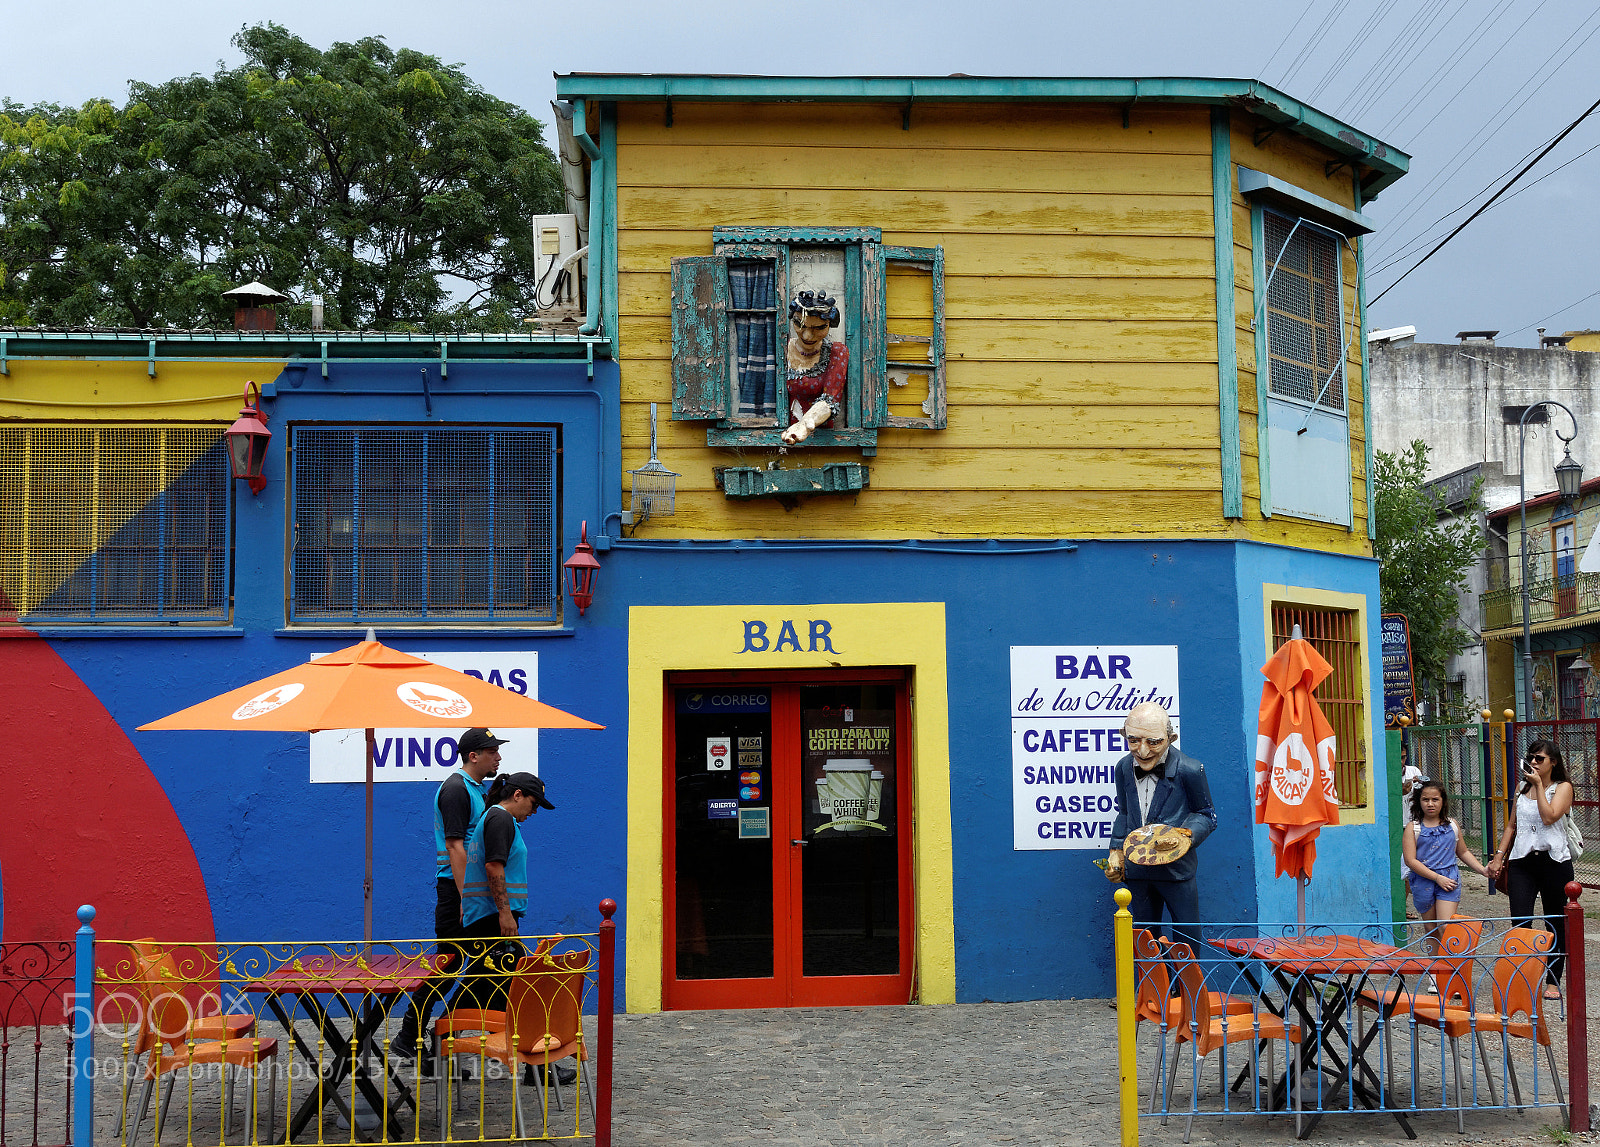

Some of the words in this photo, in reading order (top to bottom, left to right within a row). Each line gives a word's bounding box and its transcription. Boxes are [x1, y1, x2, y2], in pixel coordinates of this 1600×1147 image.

[732, 619, 844, 655] BAR
[1055, 655, 1133, 679] BAR
[711, 694, 768, 706] CORREO
[1018, 688, 1045, 711] de
[1052, 688, 1082, 711] los
[406, 698, 467, 716] BALCARCE
[808, 729, 839, 740] LISTO
[841, 728, 872, 739] PARA
[873, 728, 890, 739] UN
[1023, 729, 1129, 752] CAFETE
[740, 738, 761, 747] VISA
[808, 738, 855, 751] COFFEE
[857, 738, 890, 750] HOT?
[740, 754, 761, 763] VISA
[833, 799, 865, 808] COFFEE
